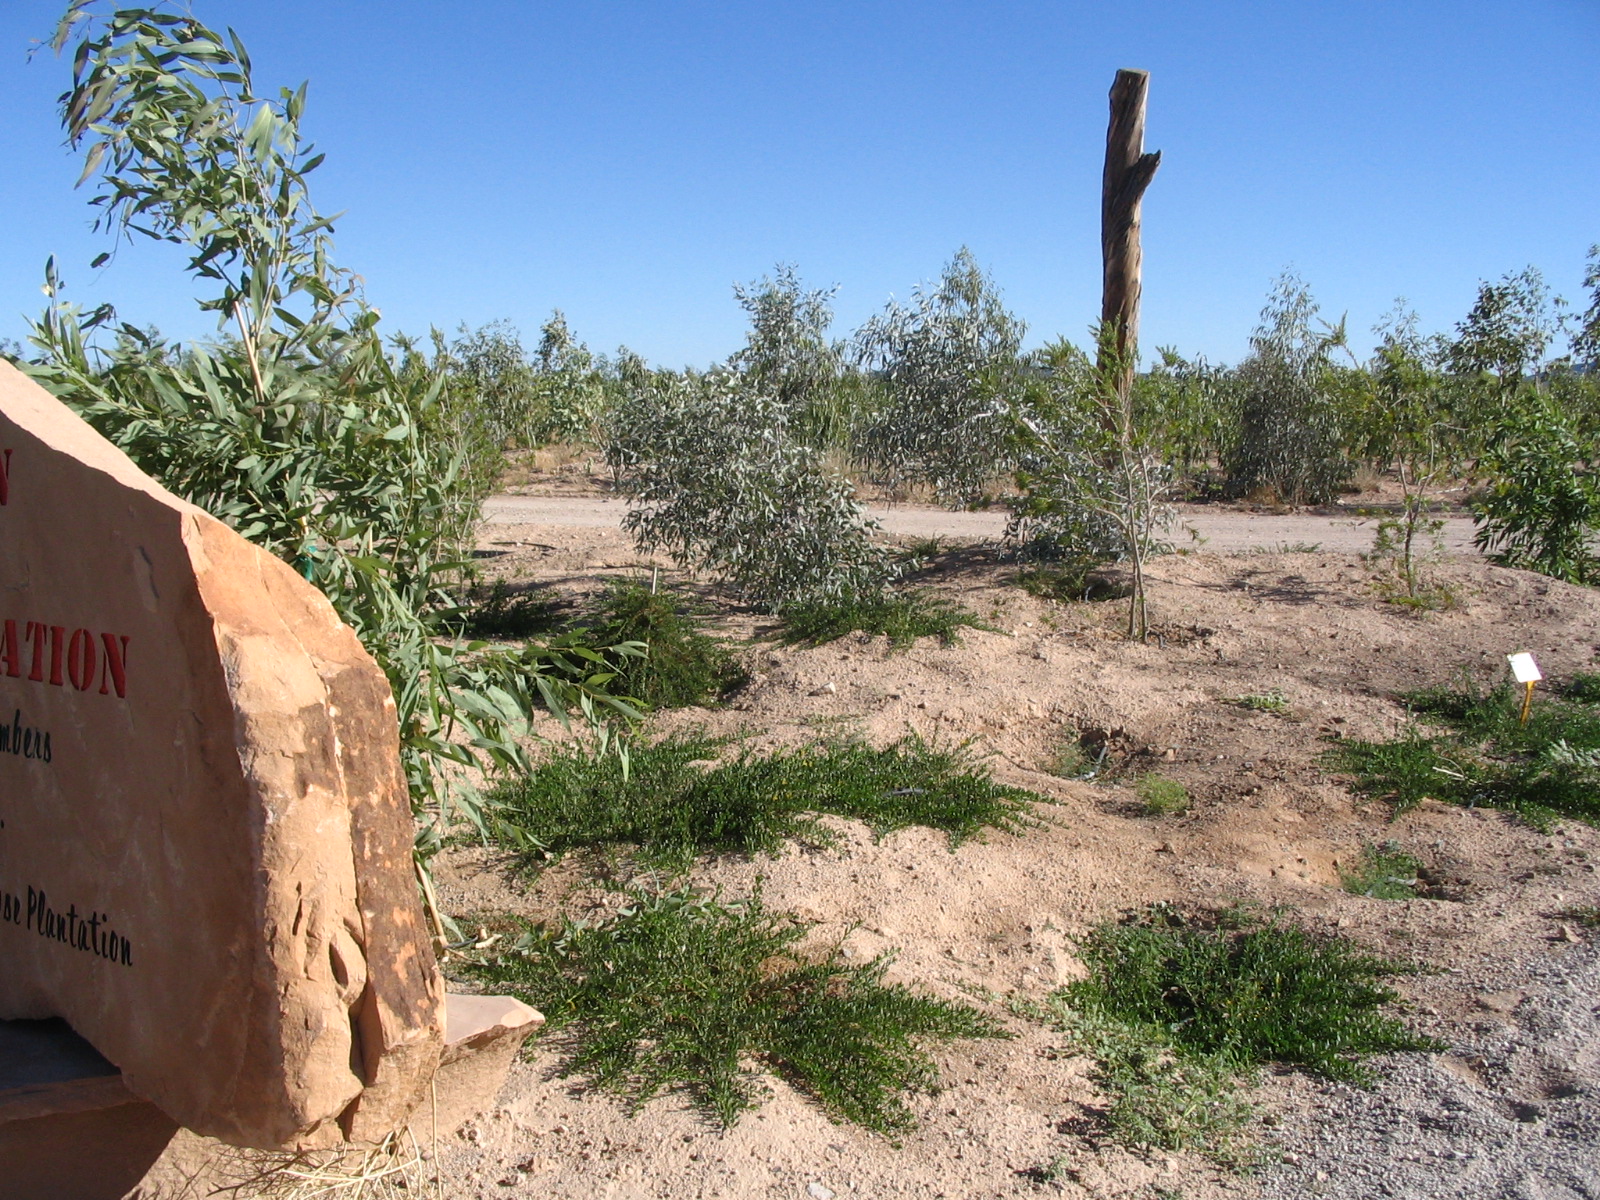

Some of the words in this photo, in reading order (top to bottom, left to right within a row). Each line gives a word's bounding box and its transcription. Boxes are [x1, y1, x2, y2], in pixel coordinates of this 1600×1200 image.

[0, 619, 130, 699] ATION
[0, 890, 21, 925] se
[27, 884, 133, 966] Plantation
